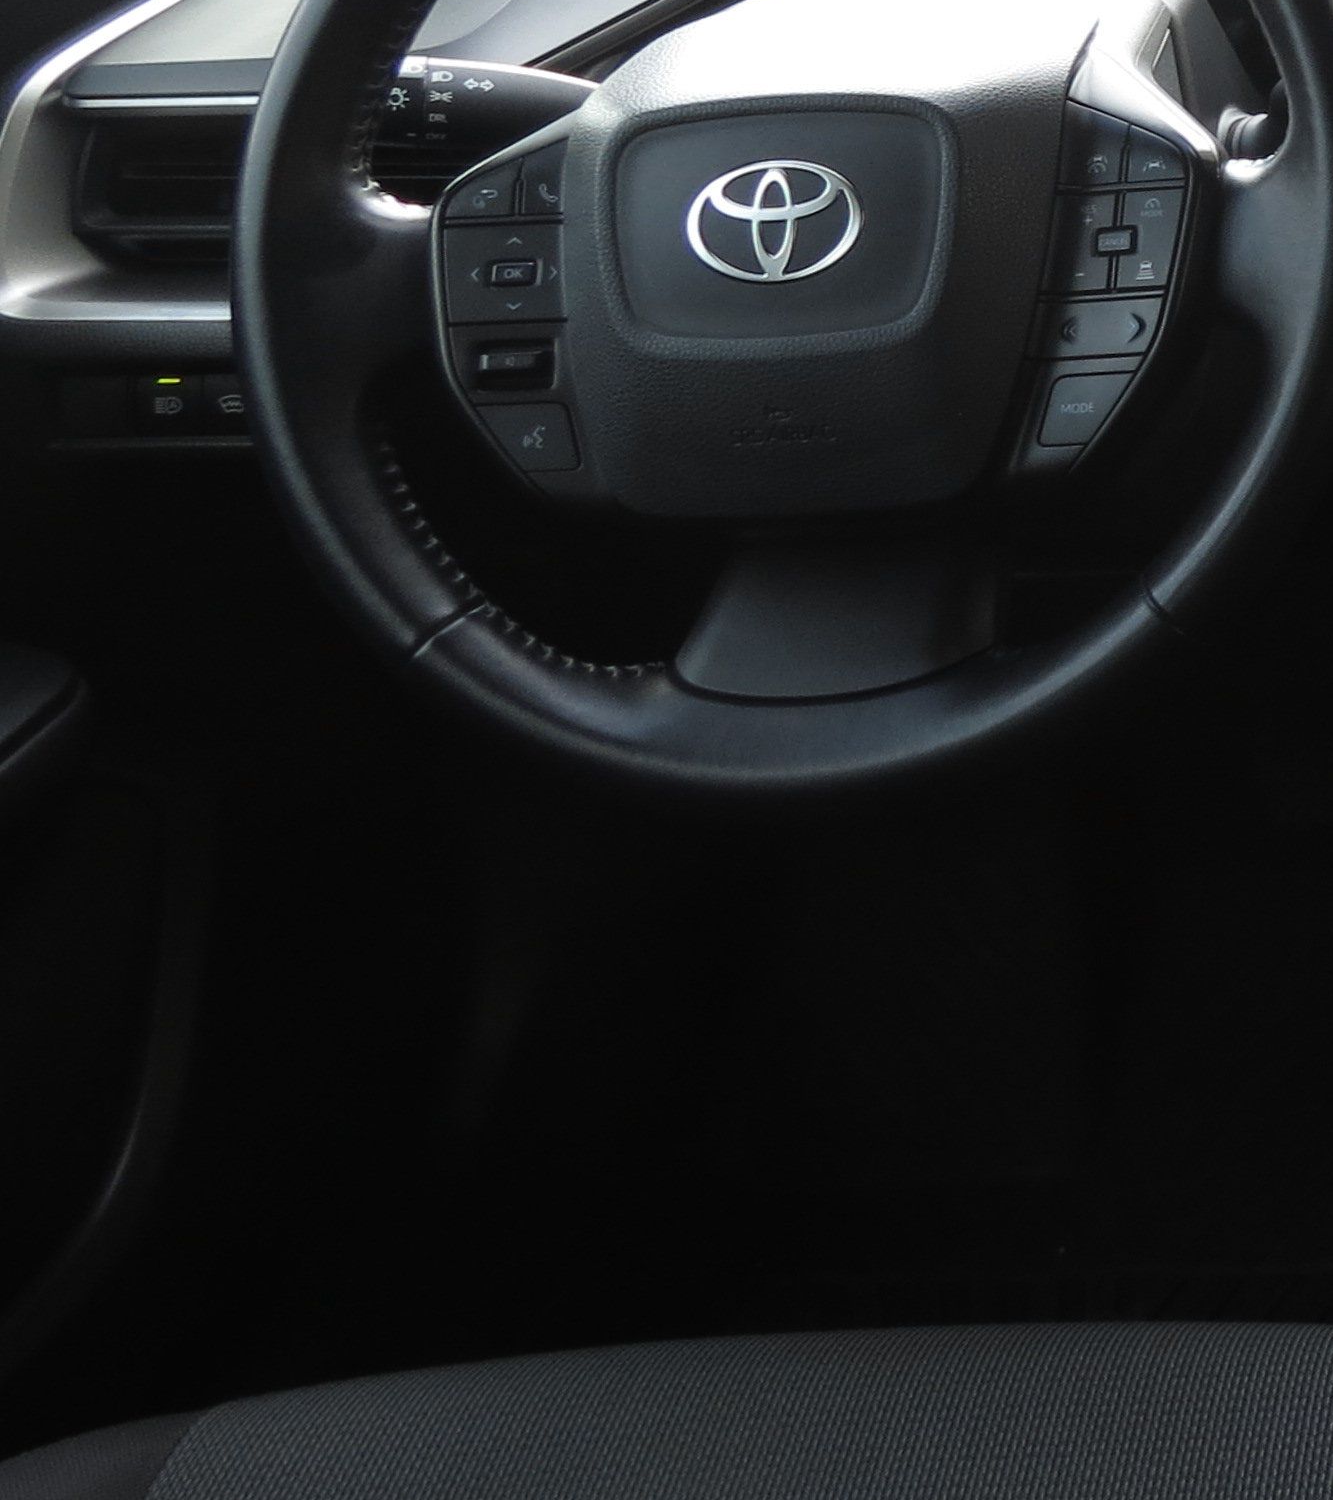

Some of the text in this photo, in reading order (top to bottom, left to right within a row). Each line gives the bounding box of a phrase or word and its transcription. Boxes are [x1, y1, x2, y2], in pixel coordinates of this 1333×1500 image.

[428, 113, 448, 124] DRL
[504, 268, 524, 280] OK
[1060, 402, 1095, 414] MODE
